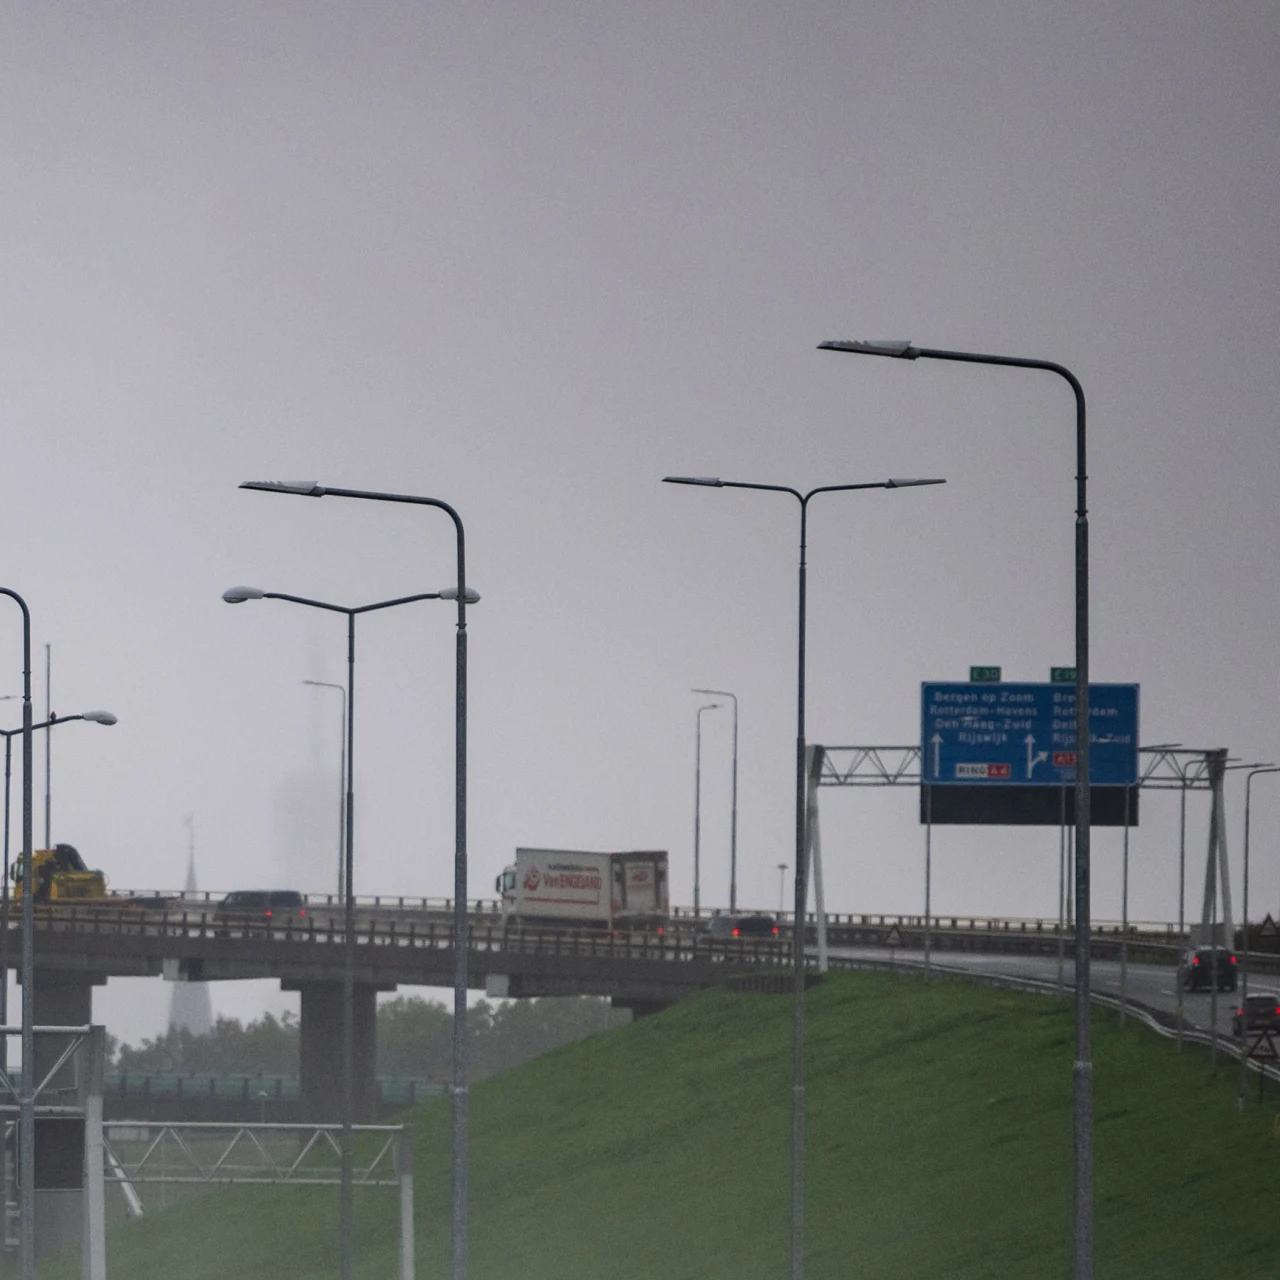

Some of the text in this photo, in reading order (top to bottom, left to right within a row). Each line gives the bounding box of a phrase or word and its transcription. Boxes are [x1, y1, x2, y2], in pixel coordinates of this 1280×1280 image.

[934, 691, 1034, 703] Bergen op Zoom
[1053, 692, 1077, 703] Bre
[935, 718, 959, 729] Den
[958, 731, 1008, 745] Rijswijk
[958, 766, 986, 775] RING
